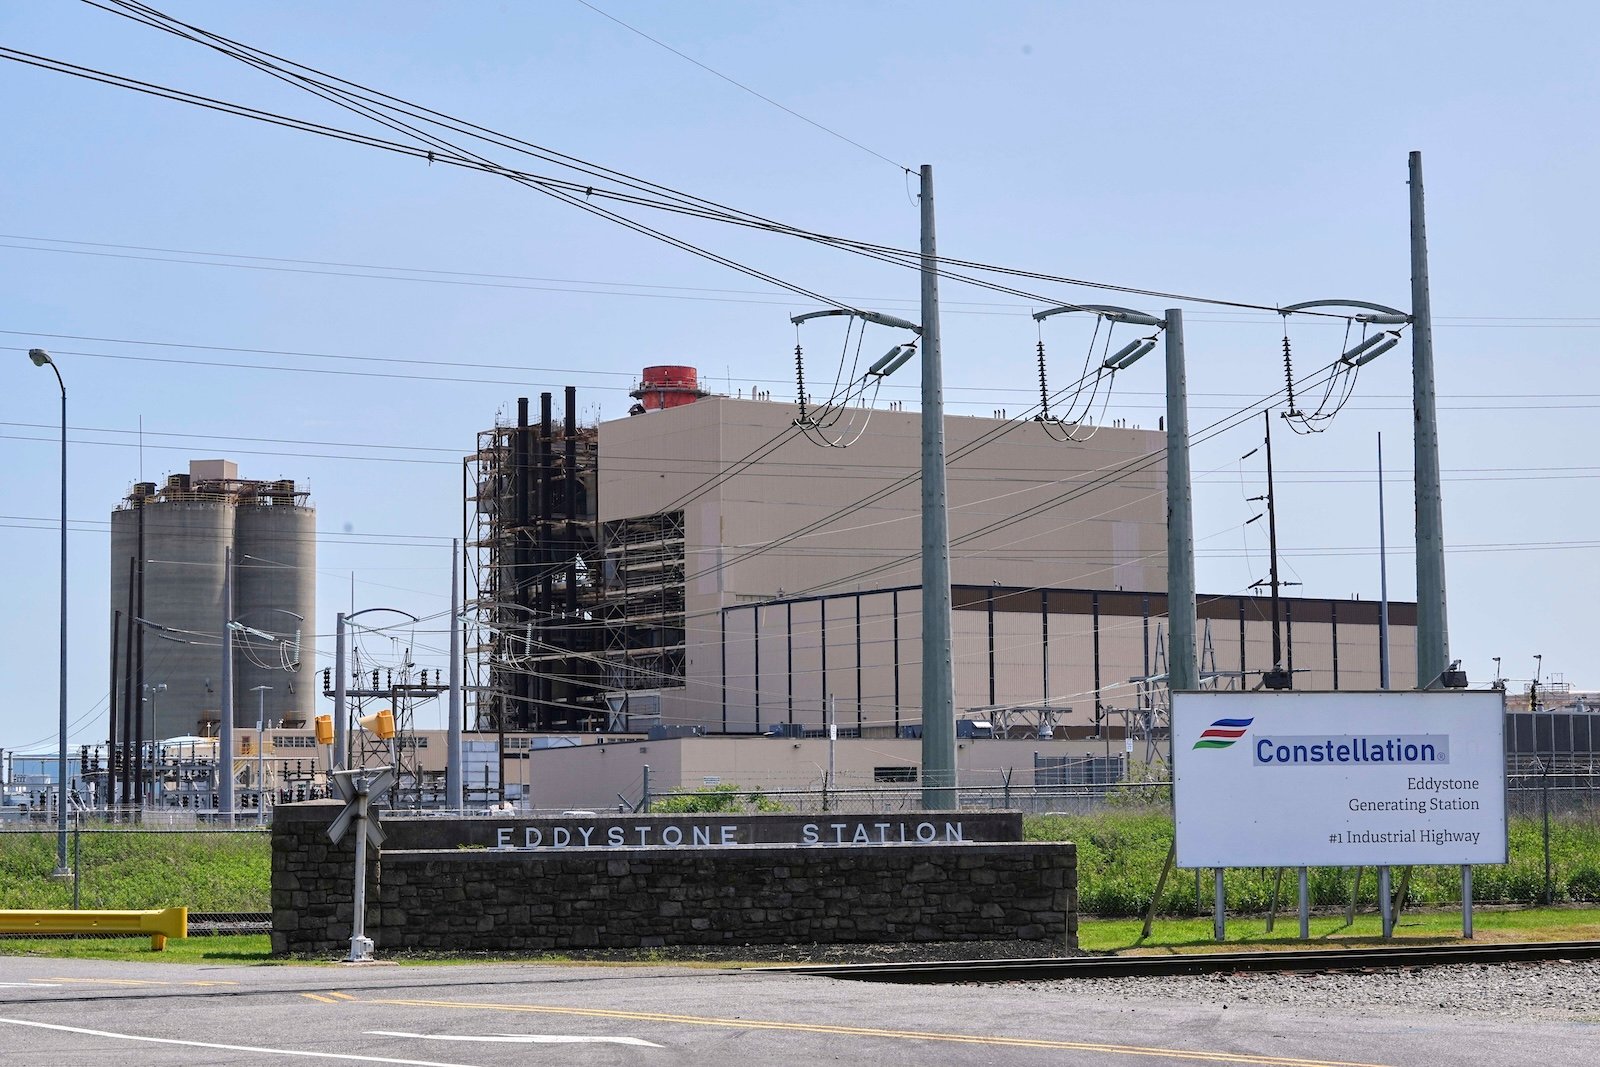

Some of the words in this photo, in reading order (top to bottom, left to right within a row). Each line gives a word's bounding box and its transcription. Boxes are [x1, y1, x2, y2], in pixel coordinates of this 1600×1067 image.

[1256, 738, 1435, 763] Constellation
[1407, 776, 1480, 794] Eddystone
[1348, 797, 1427, 815] Generating
[1429, 796, 1480, 813] Station
[496, 824, 738, 848] EDDYSTONE
[802, 822, 963, 845] STATION
[1328, 831, 1343, 845] #1
[1346, 830, 1416, 845] Industrial
[1419, 828, 1480, 848] Highway
